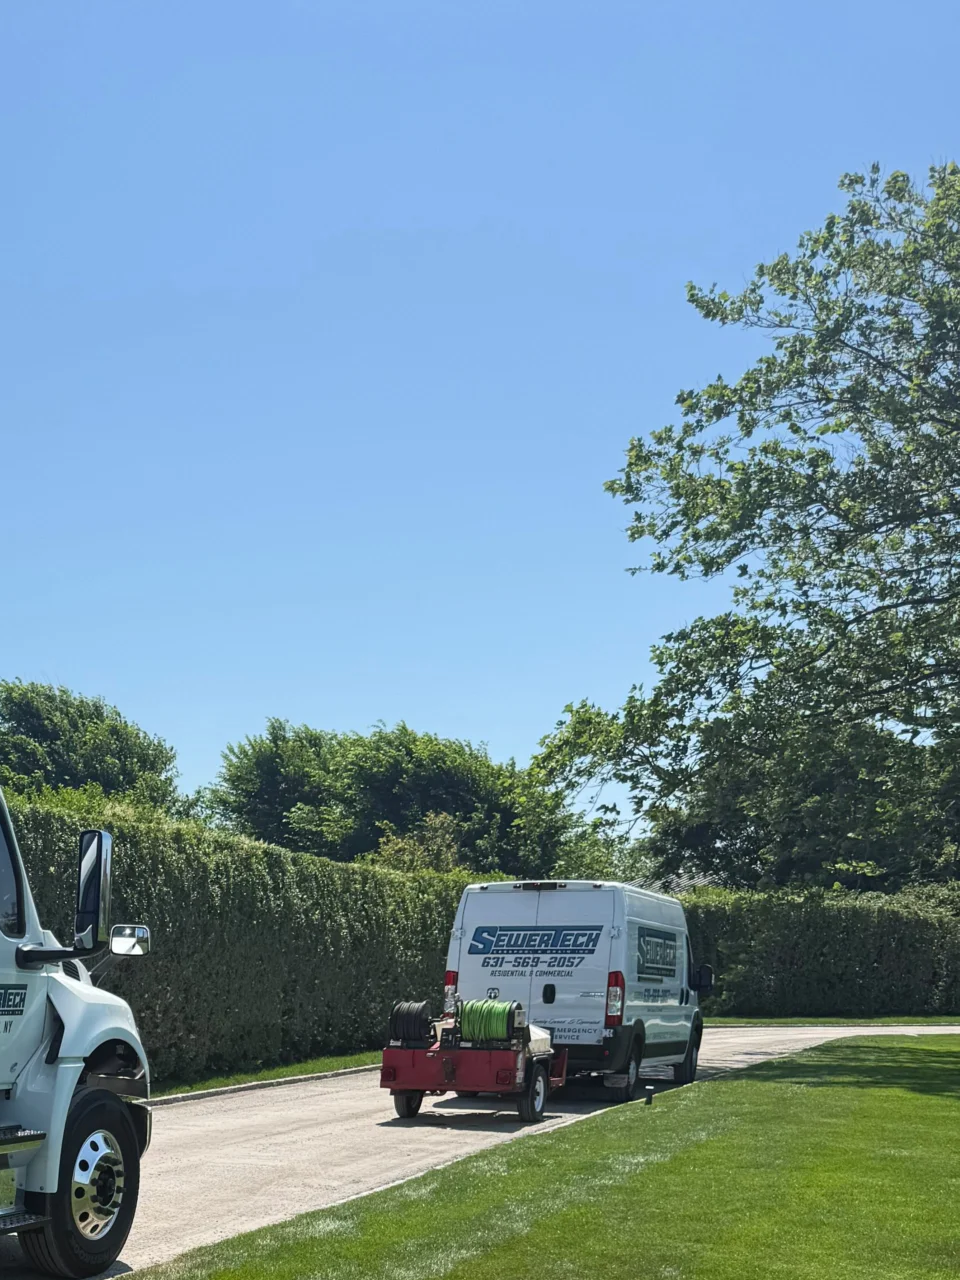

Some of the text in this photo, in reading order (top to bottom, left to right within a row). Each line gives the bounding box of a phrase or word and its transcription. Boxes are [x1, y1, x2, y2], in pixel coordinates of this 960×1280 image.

[481, 956, 585, 968] 631-569-2057
[490, 969, 527, 977] RESIDENTIAL
[3, 1021, 13, 1034] NY
